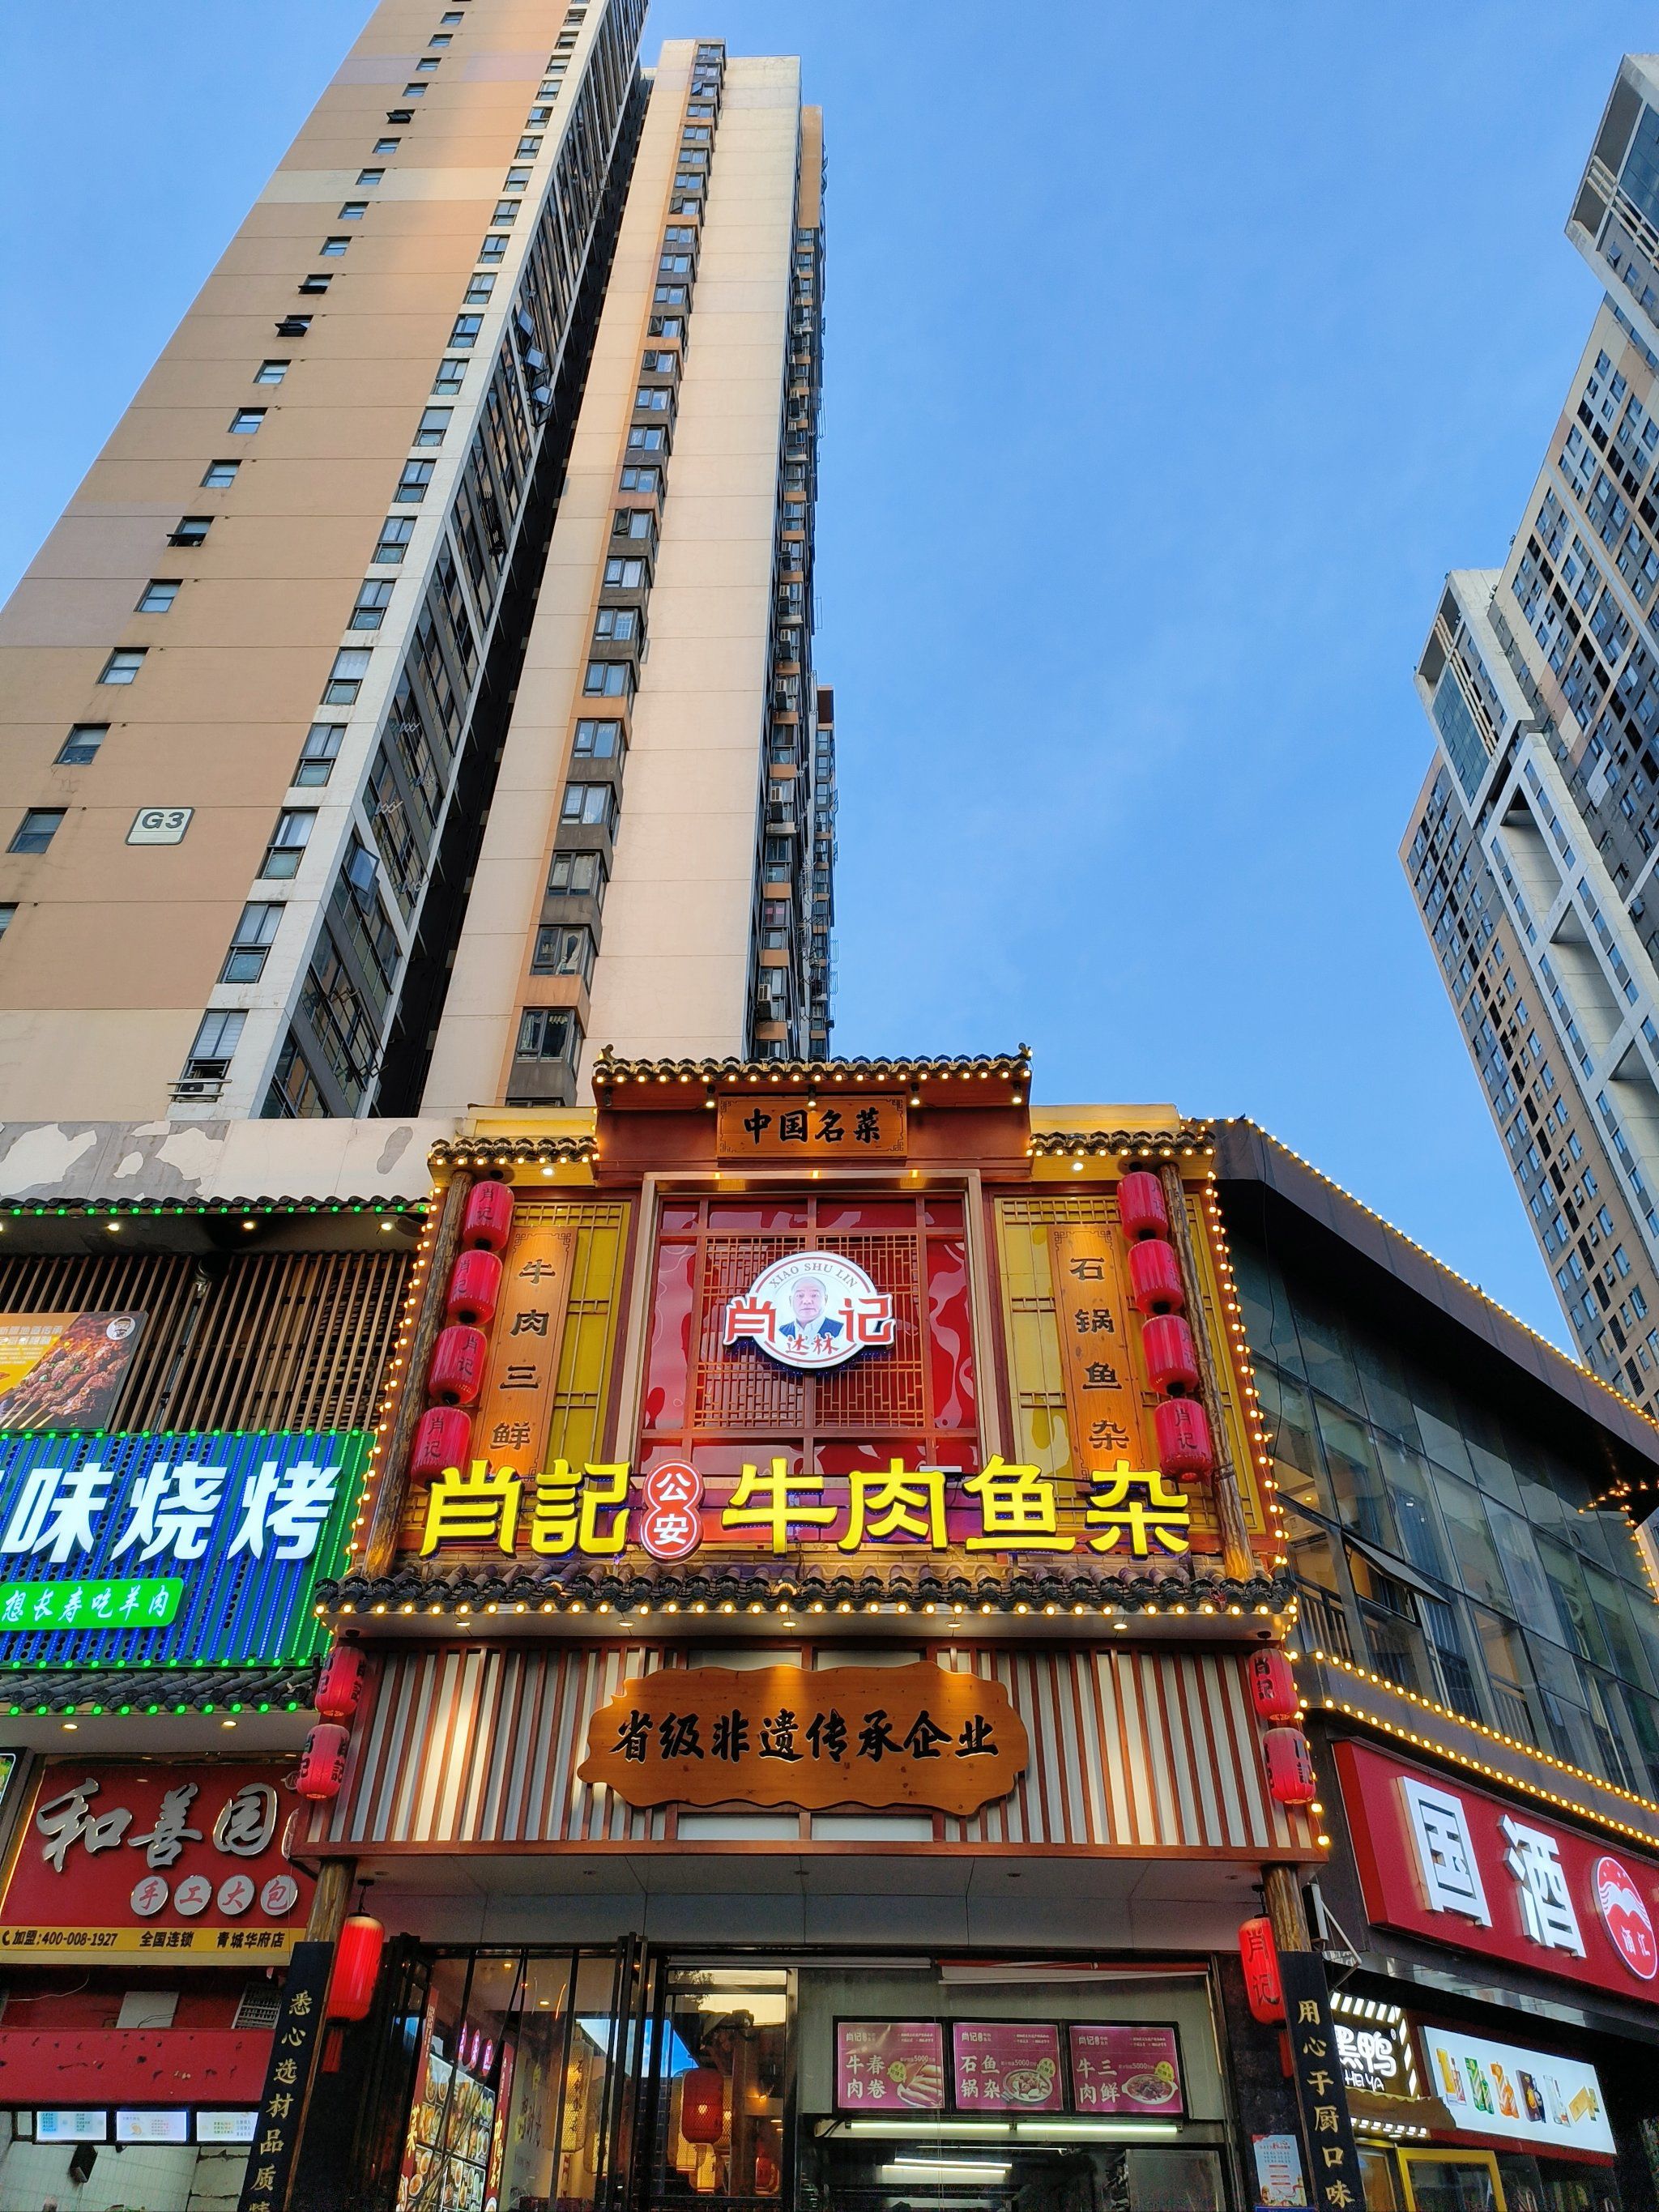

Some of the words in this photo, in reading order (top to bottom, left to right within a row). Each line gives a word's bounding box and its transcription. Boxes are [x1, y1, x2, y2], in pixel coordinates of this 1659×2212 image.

[142, 812, 185, 829] G3
[744, 1107, 881, 1144] 中国名菜
[769, 1265, 800, 1288] XIAO
[804, 1262, 834, 1273] SHU
[836, 1268, 858, 1288] LIN
[725, 1296, 892, 1344] 肖记
[491, 1259, 557, 1451] 牛肉三鲜
[1068, 1257, 1129, 1451] 石锅鱼杂
[0, 1461, 342, 1562] 味烧烤
[420, 1459, 629, 1556] 肖記
[654, 1473, 691, 1545] 公安
[722, 1455, 1189, 1554] 牛肉鱼杂
[2, 1584, 169, 1623] 想长寿吃羊肉
[609, 1709, 1000, 1763] 省级非遗传承企业
[36, 1777, 278, 1873] 和善园
[1397, 1776, 1587, 1958] 国酒
[139, 1879, 288, 1910] 手工大包
[139, 1931, 194, 1948] 全国连锁
[216, 1932, 285, 1949] 青城华府店
[1298, 2000, 1355, 2209] 用心于厨口味
